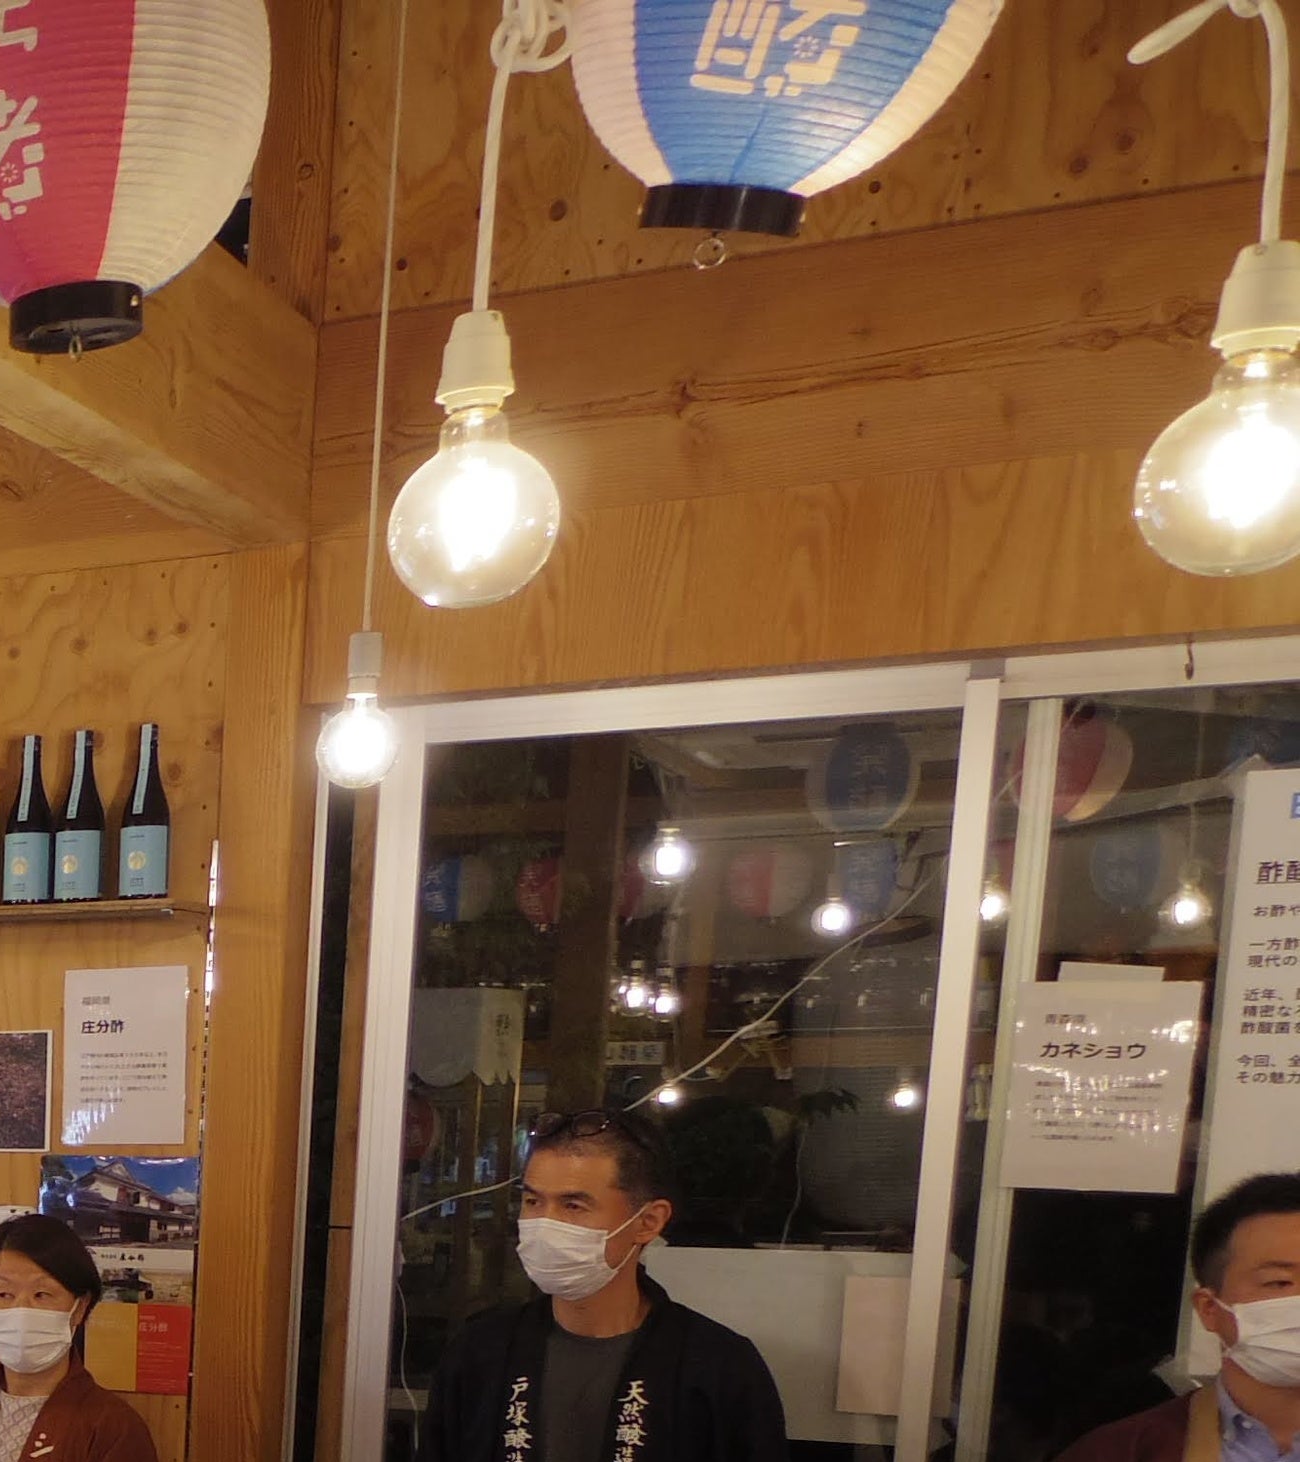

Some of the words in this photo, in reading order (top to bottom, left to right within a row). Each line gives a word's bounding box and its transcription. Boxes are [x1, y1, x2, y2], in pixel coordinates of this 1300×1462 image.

[80, 1019, 125, 1035] 庄分酢
[1039, 1042, 1147, 1060] カネショウ
